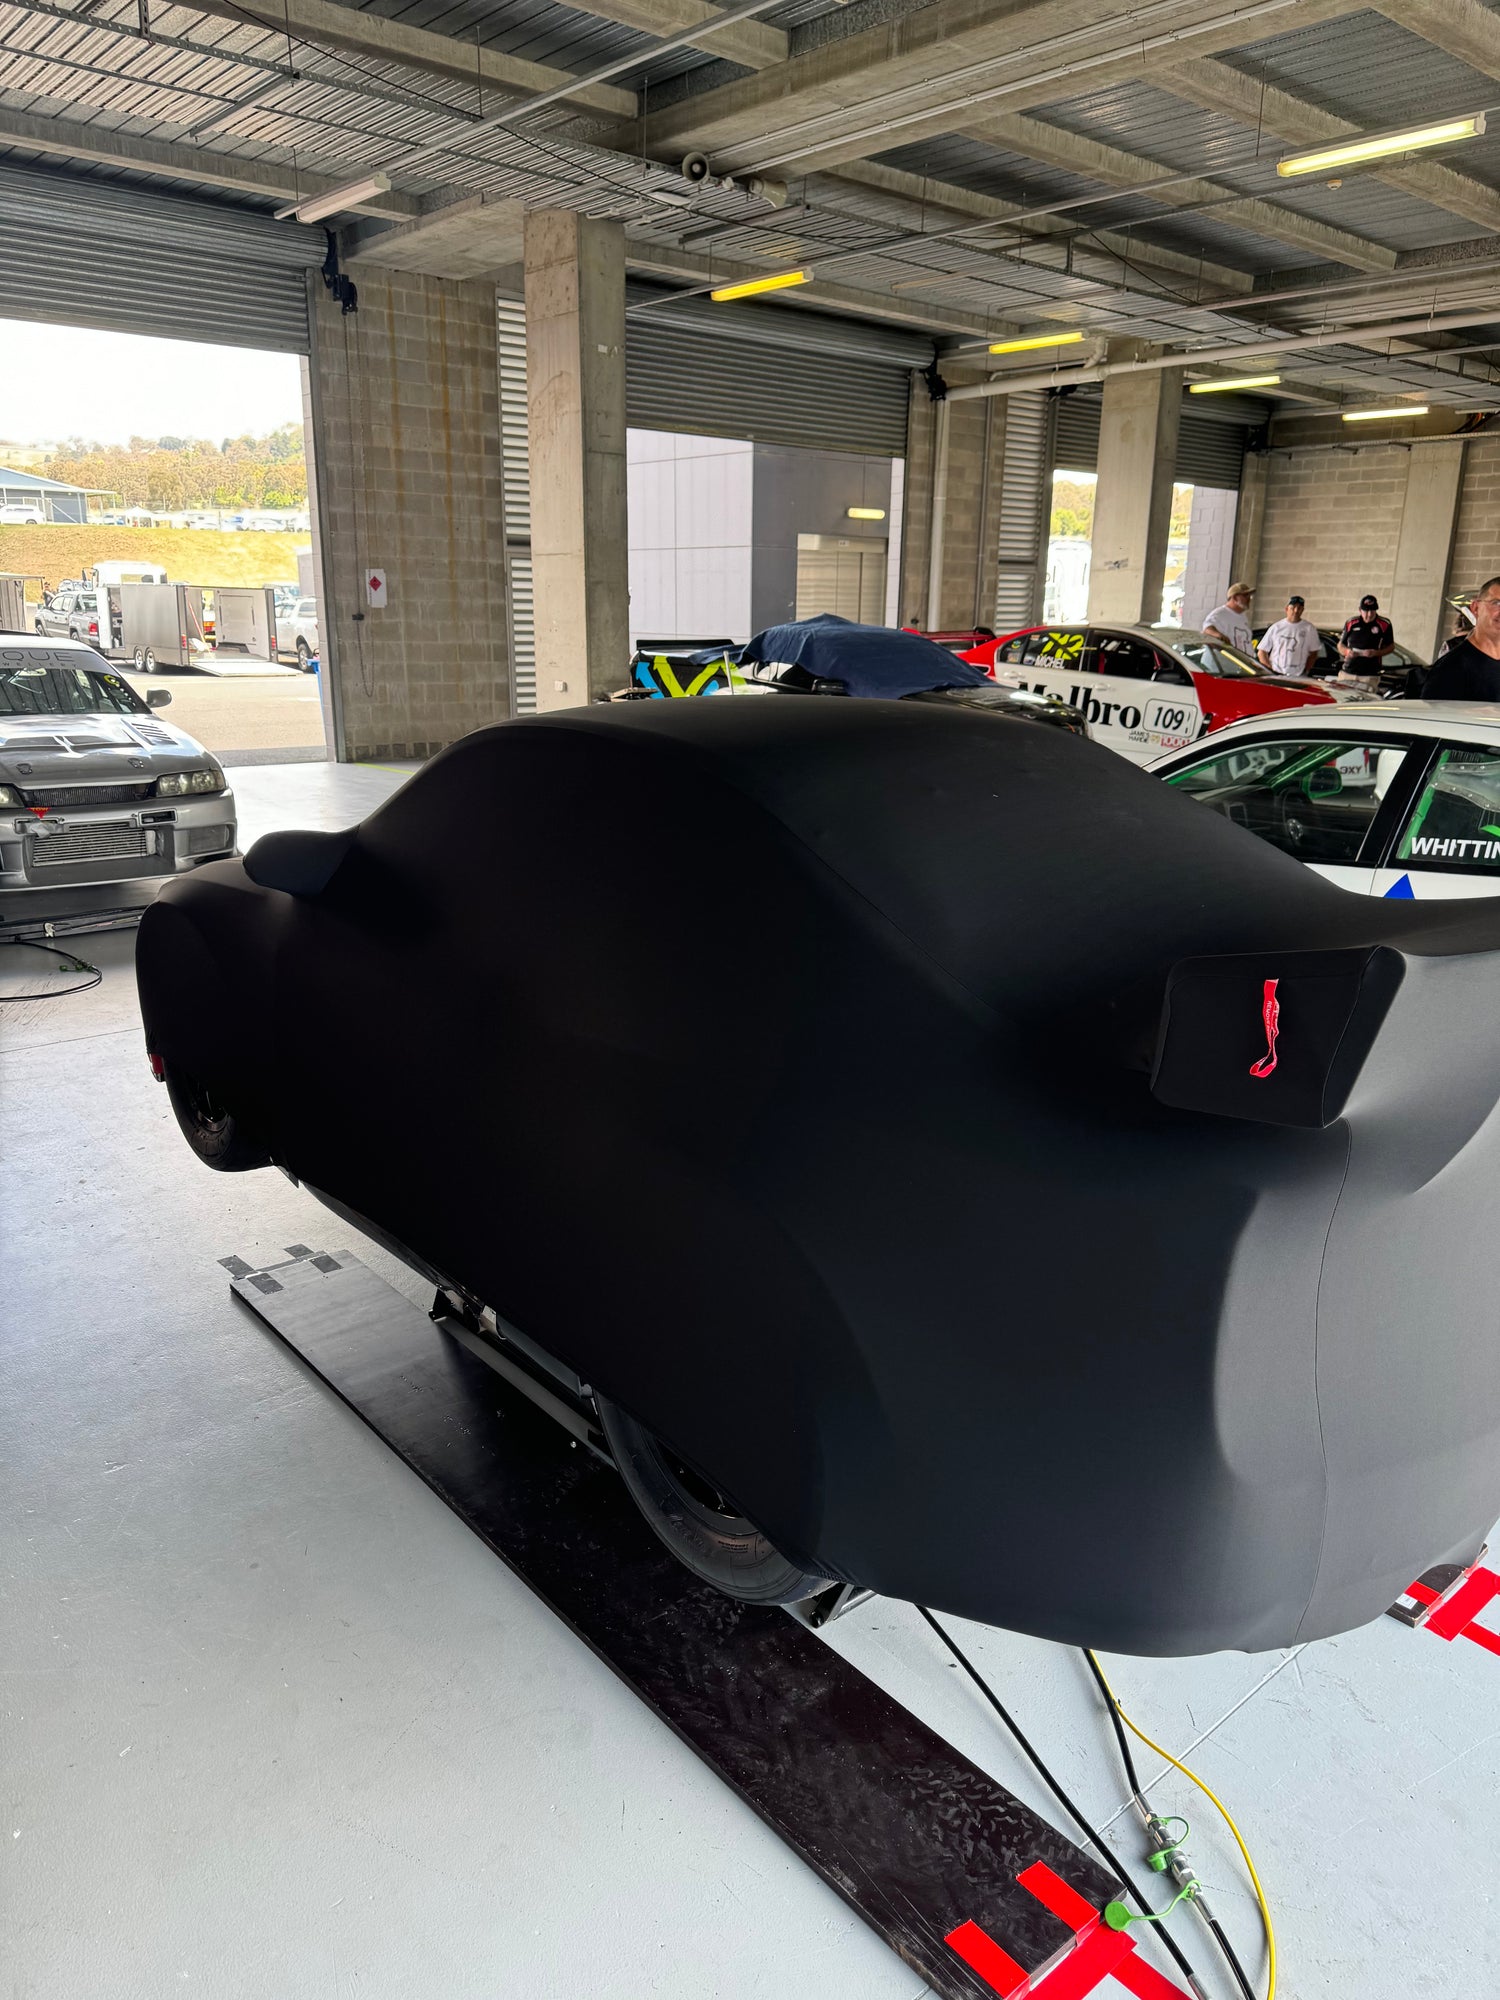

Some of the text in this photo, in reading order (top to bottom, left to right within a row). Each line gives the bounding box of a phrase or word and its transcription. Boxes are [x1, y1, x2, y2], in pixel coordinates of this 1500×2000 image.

[2, 651, 75, 662] QUE
[1035, 655, 1065, 669] MICHEL
[1154, 706, 1185, 730] 109
